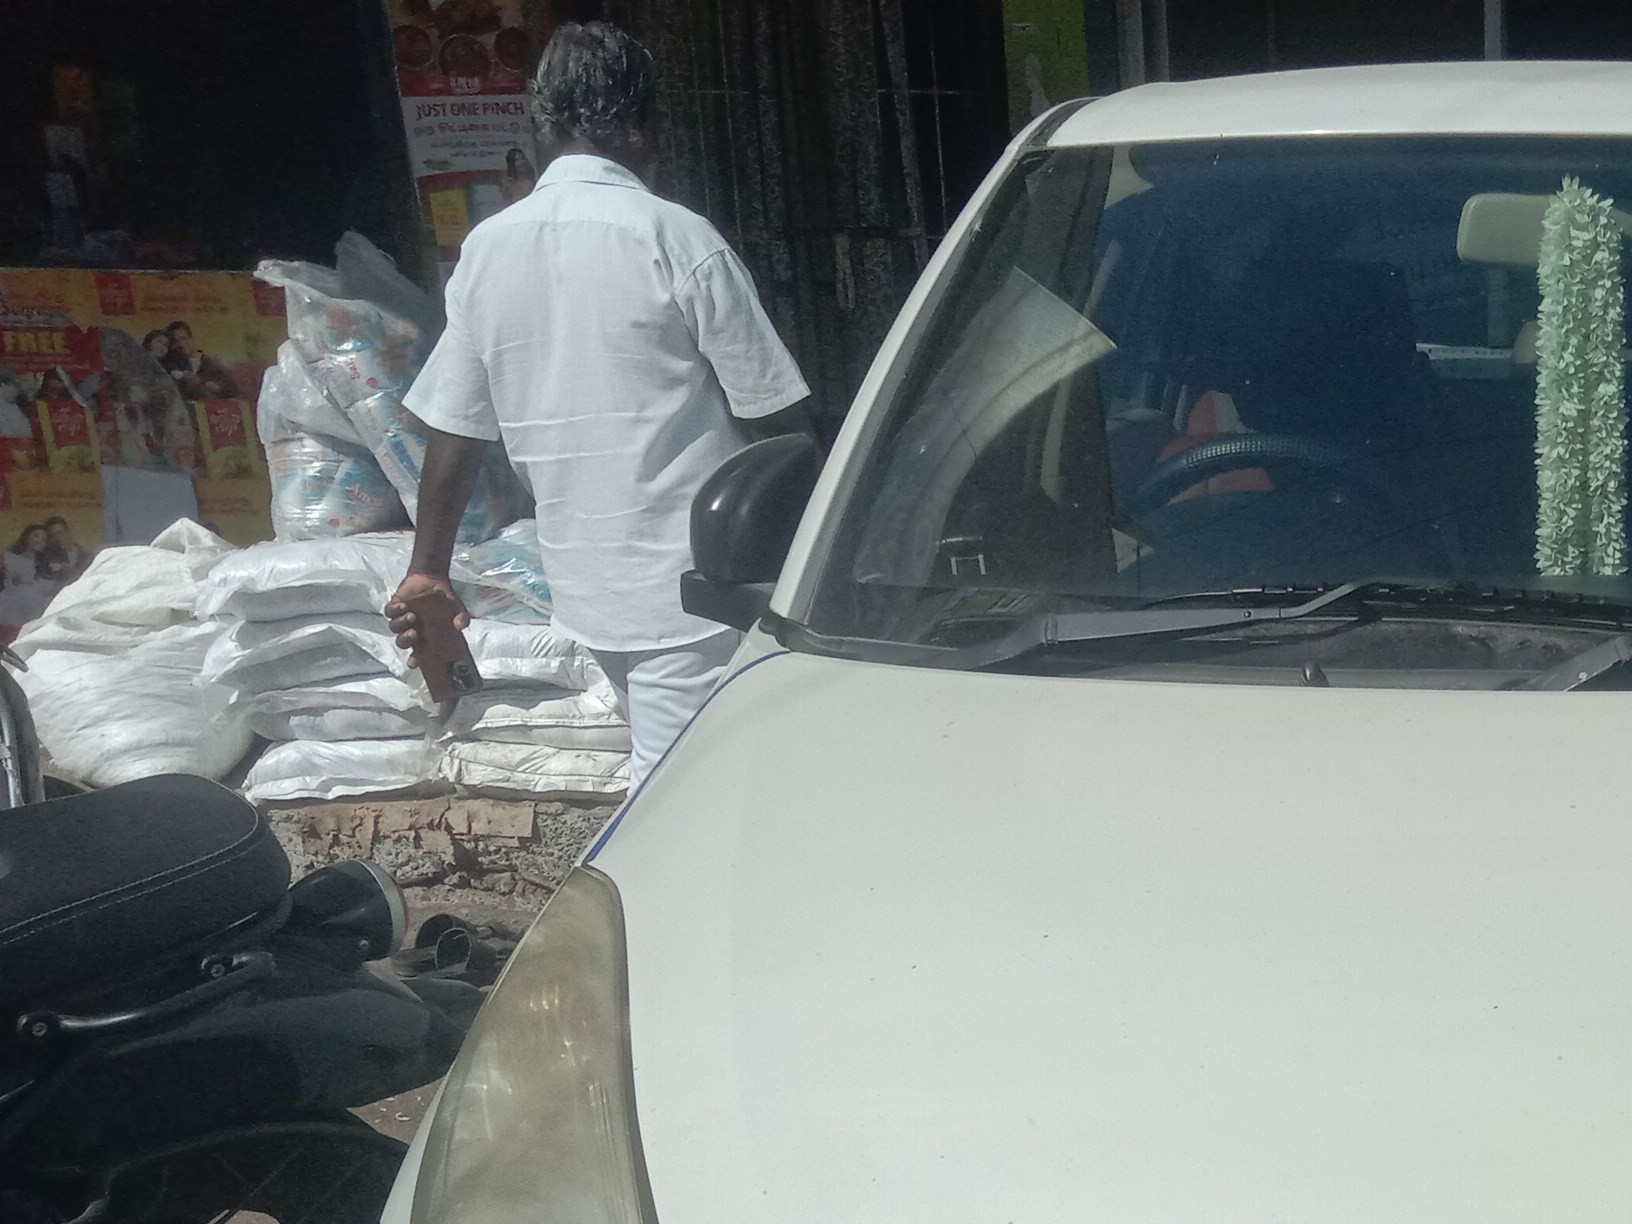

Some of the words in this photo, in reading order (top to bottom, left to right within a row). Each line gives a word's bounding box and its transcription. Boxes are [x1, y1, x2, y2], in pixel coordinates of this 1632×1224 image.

[415, 103, 447, 121] JUST
[451, 102, 480, 117] ONE
[482, 101, 525, 116] PINCH
[3, 330, 69, 354] FREE
